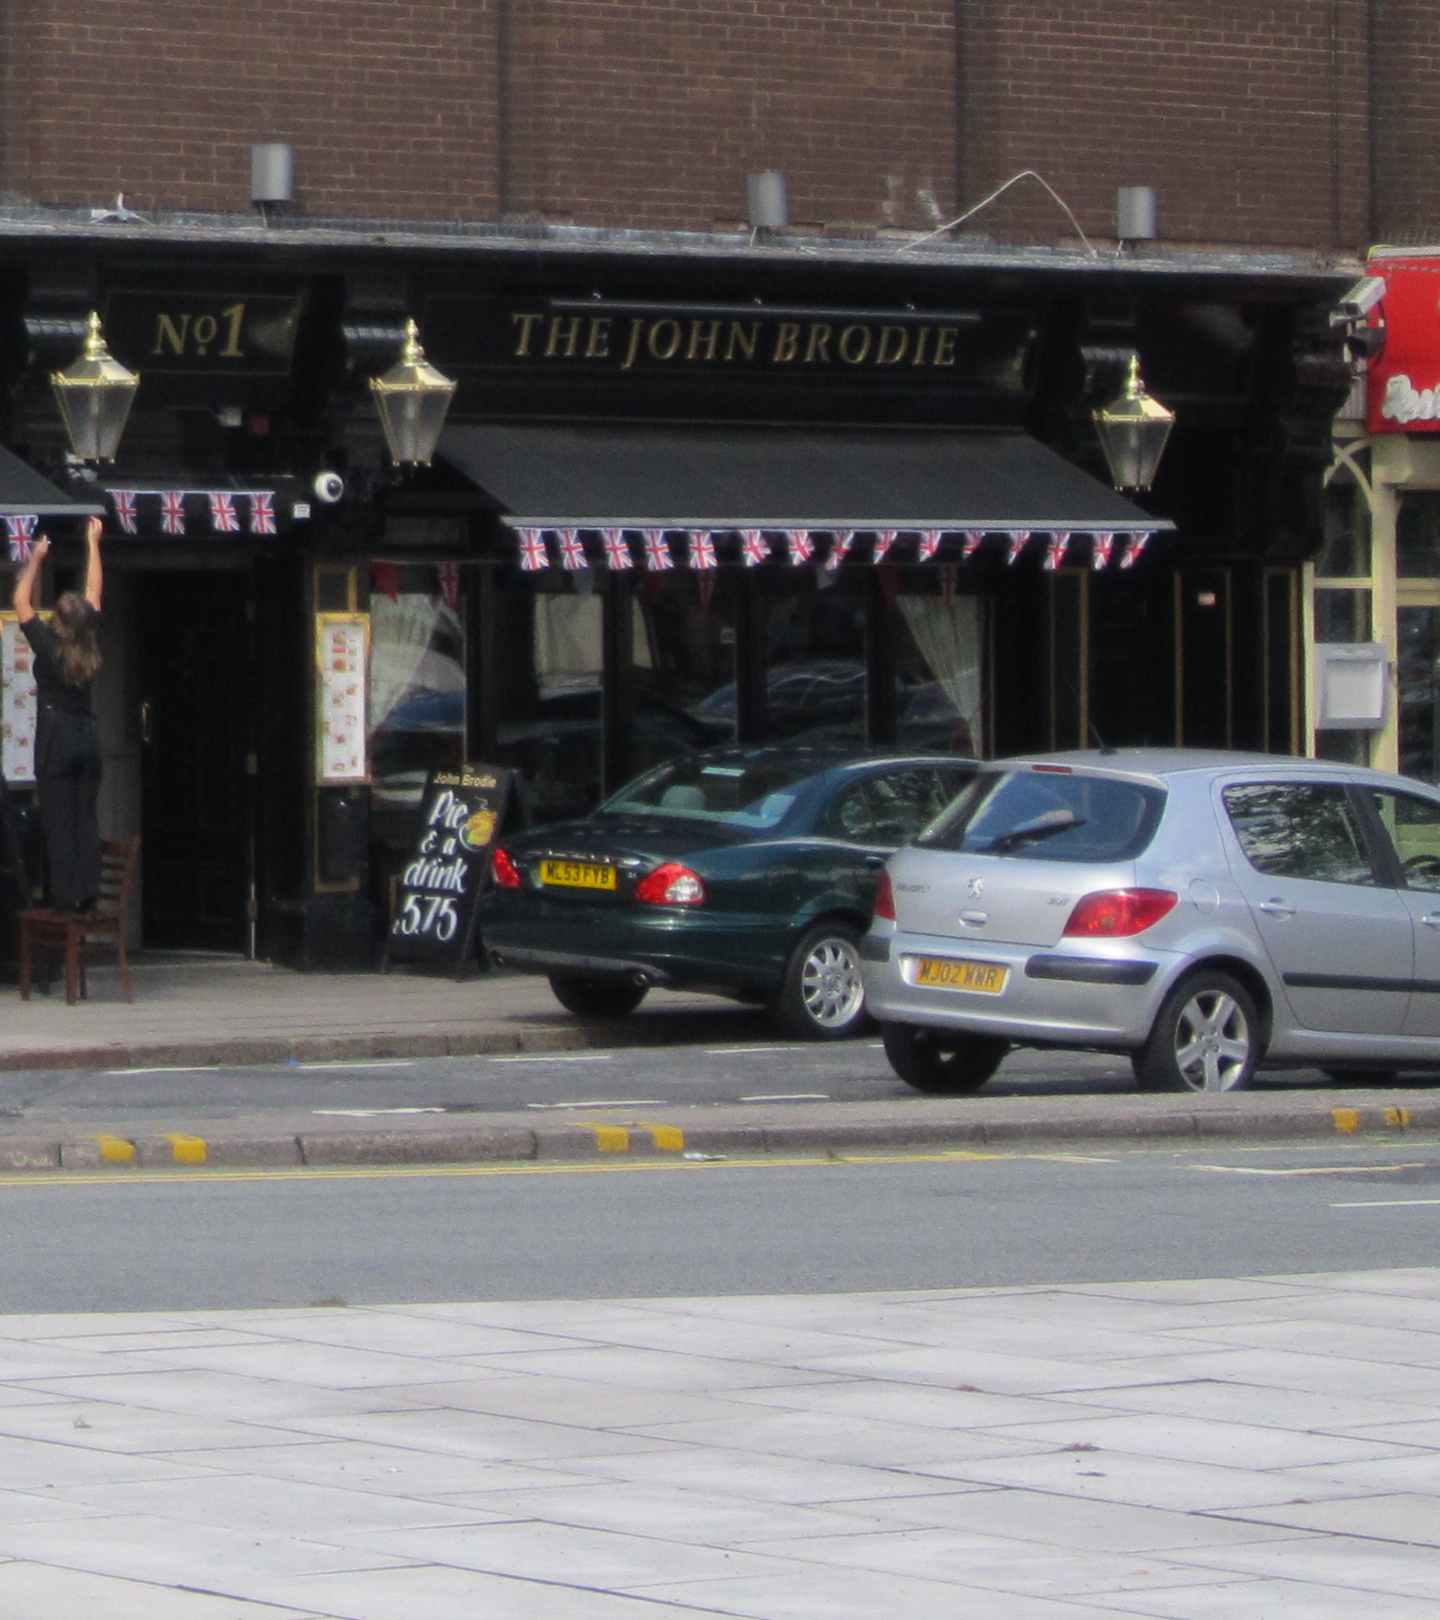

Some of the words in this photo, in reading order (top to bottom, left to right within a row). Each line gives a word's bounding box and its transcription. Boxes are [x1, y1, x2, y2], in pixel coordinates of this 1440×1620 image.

[511, 313, 613, 358] THE
[620, 318, 762, 370] JOHN
[772, 322, 959, 366] BRODIE
[433, 772, 460, 785] John
[462, 773, 497, 789] Brodie
[428, 789, 469, 829] Pie
[421, 830, 438, 855] &
[442, 836, 457, 856] a
[403, 857, 469, 894] drink
[546, 861, 580, 883] ML53
[583, 864, 609, 885] FYB
[919, 960, 962, 984] MJ02
